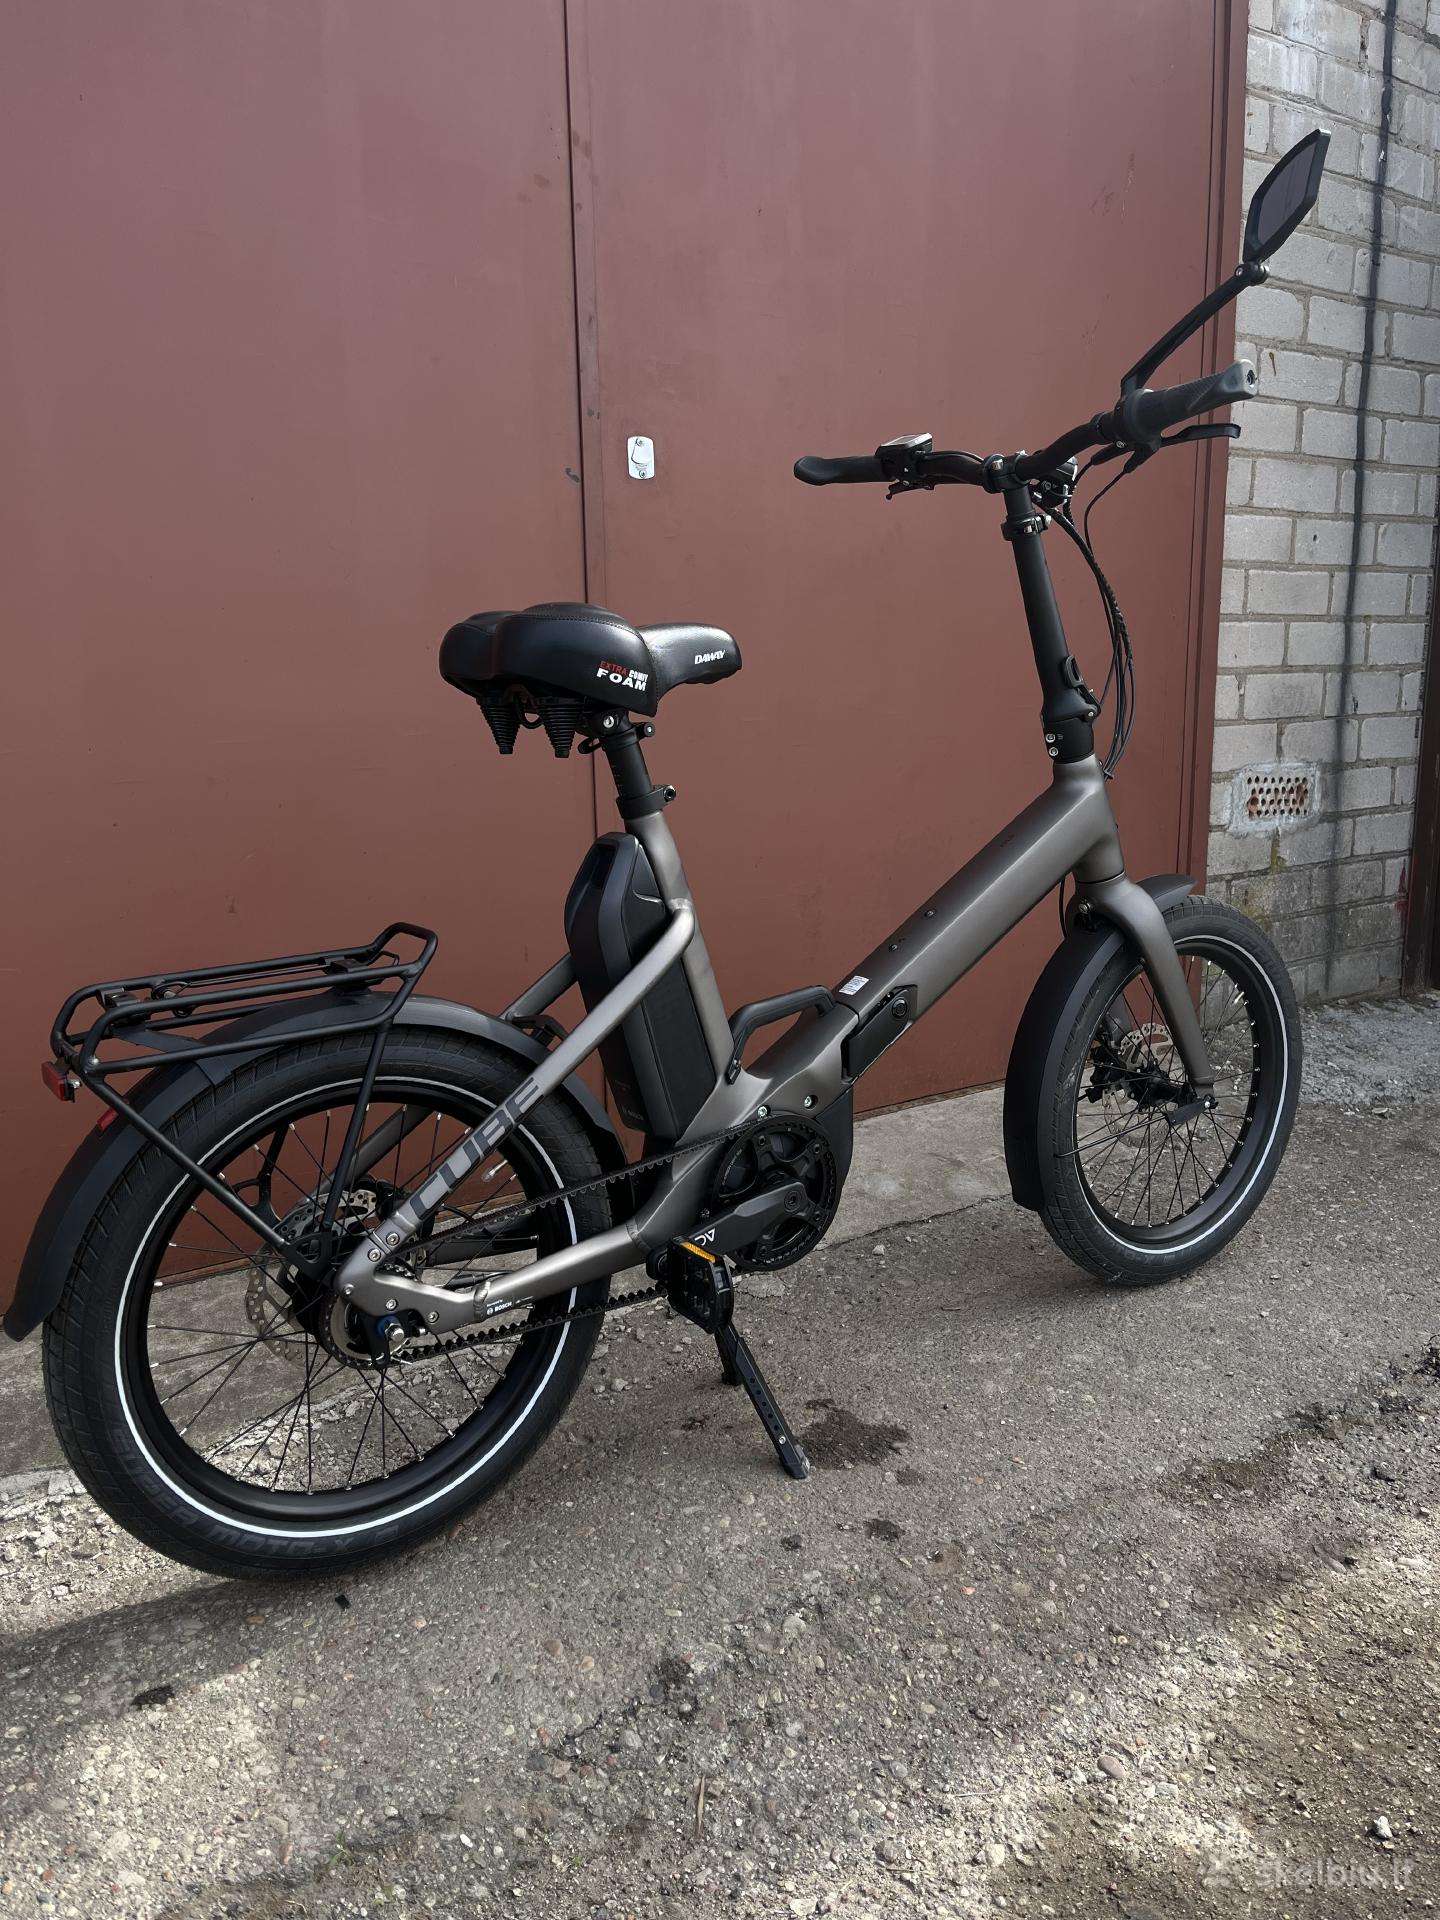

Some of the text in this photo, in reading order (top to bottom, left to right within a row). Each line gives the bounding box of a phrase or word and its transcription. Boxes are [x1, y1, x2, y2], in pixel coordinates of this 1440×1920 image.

[596, 667, 647, 691] FOAM
[599, 660, 627, 676] EXTRA
[409, 1076, 545, 1220] CUBE
